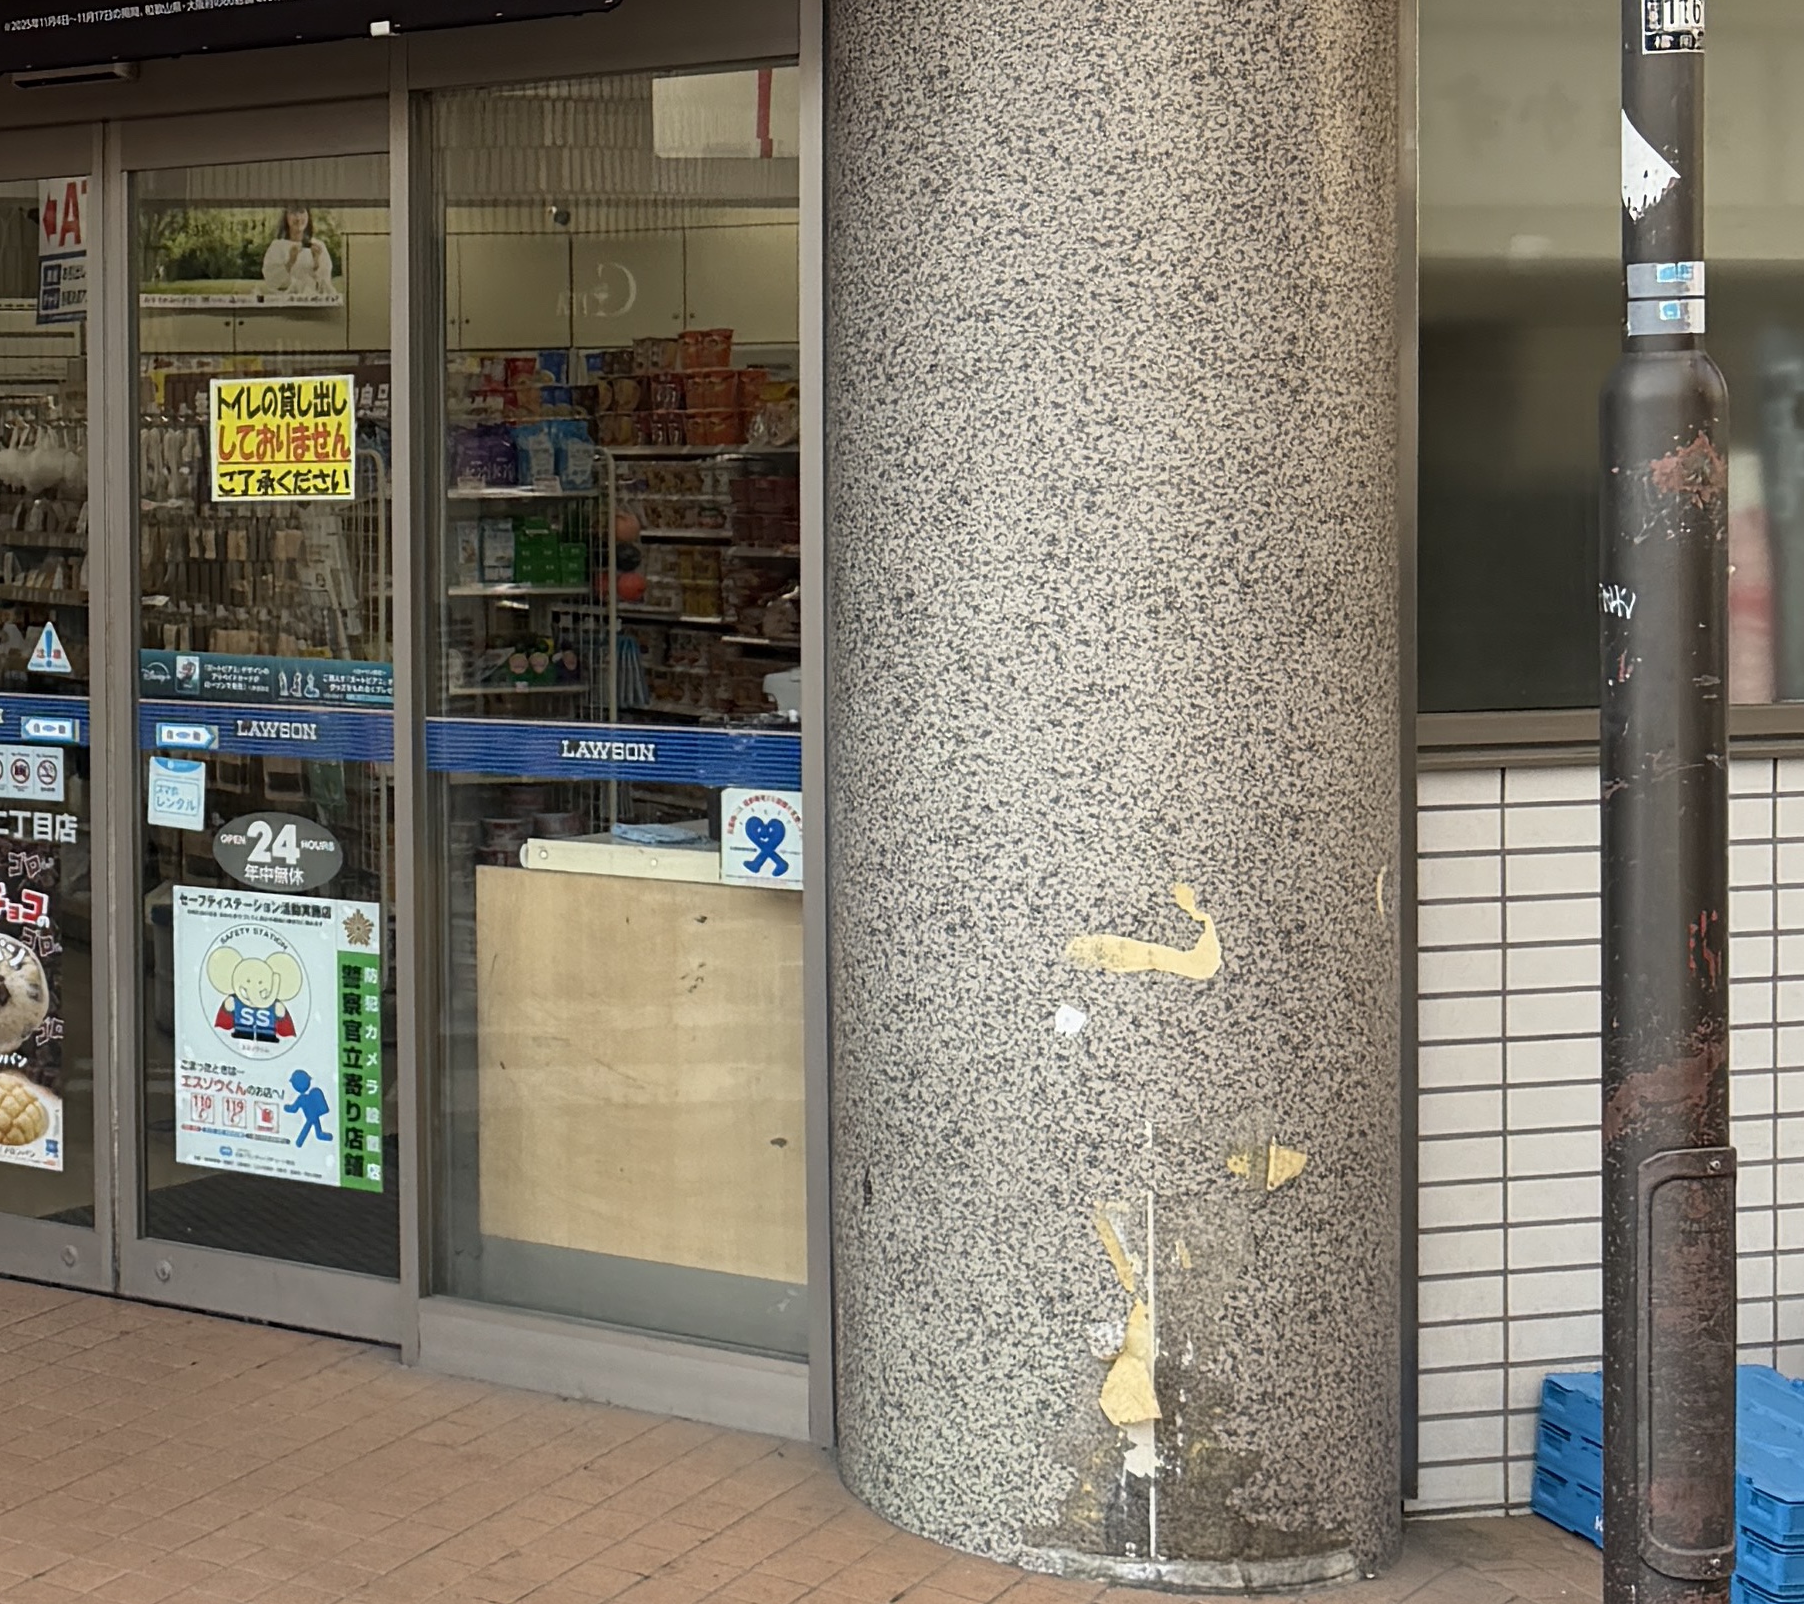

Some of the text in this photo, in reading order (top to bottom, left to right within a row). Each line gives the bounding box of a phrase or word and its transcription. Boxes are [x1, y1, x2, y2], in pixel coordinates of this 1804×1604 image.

[217, 381, 348, 420] トイレの貸し出し
[218, 421, 351, 461] しておりません
[218, 469, 350, 496] ご了承ください
[236, 720, 317, 740] LAWSON
[561, 740, 656, 762] LAWSON
[220, 820, 335, 864] OPEN 24 HOURS
[244, 864, 305, 886] 年中無休
[220, 927, 288, 950] SAFETY STATION
[240, 1007, 270, 1027] SS
